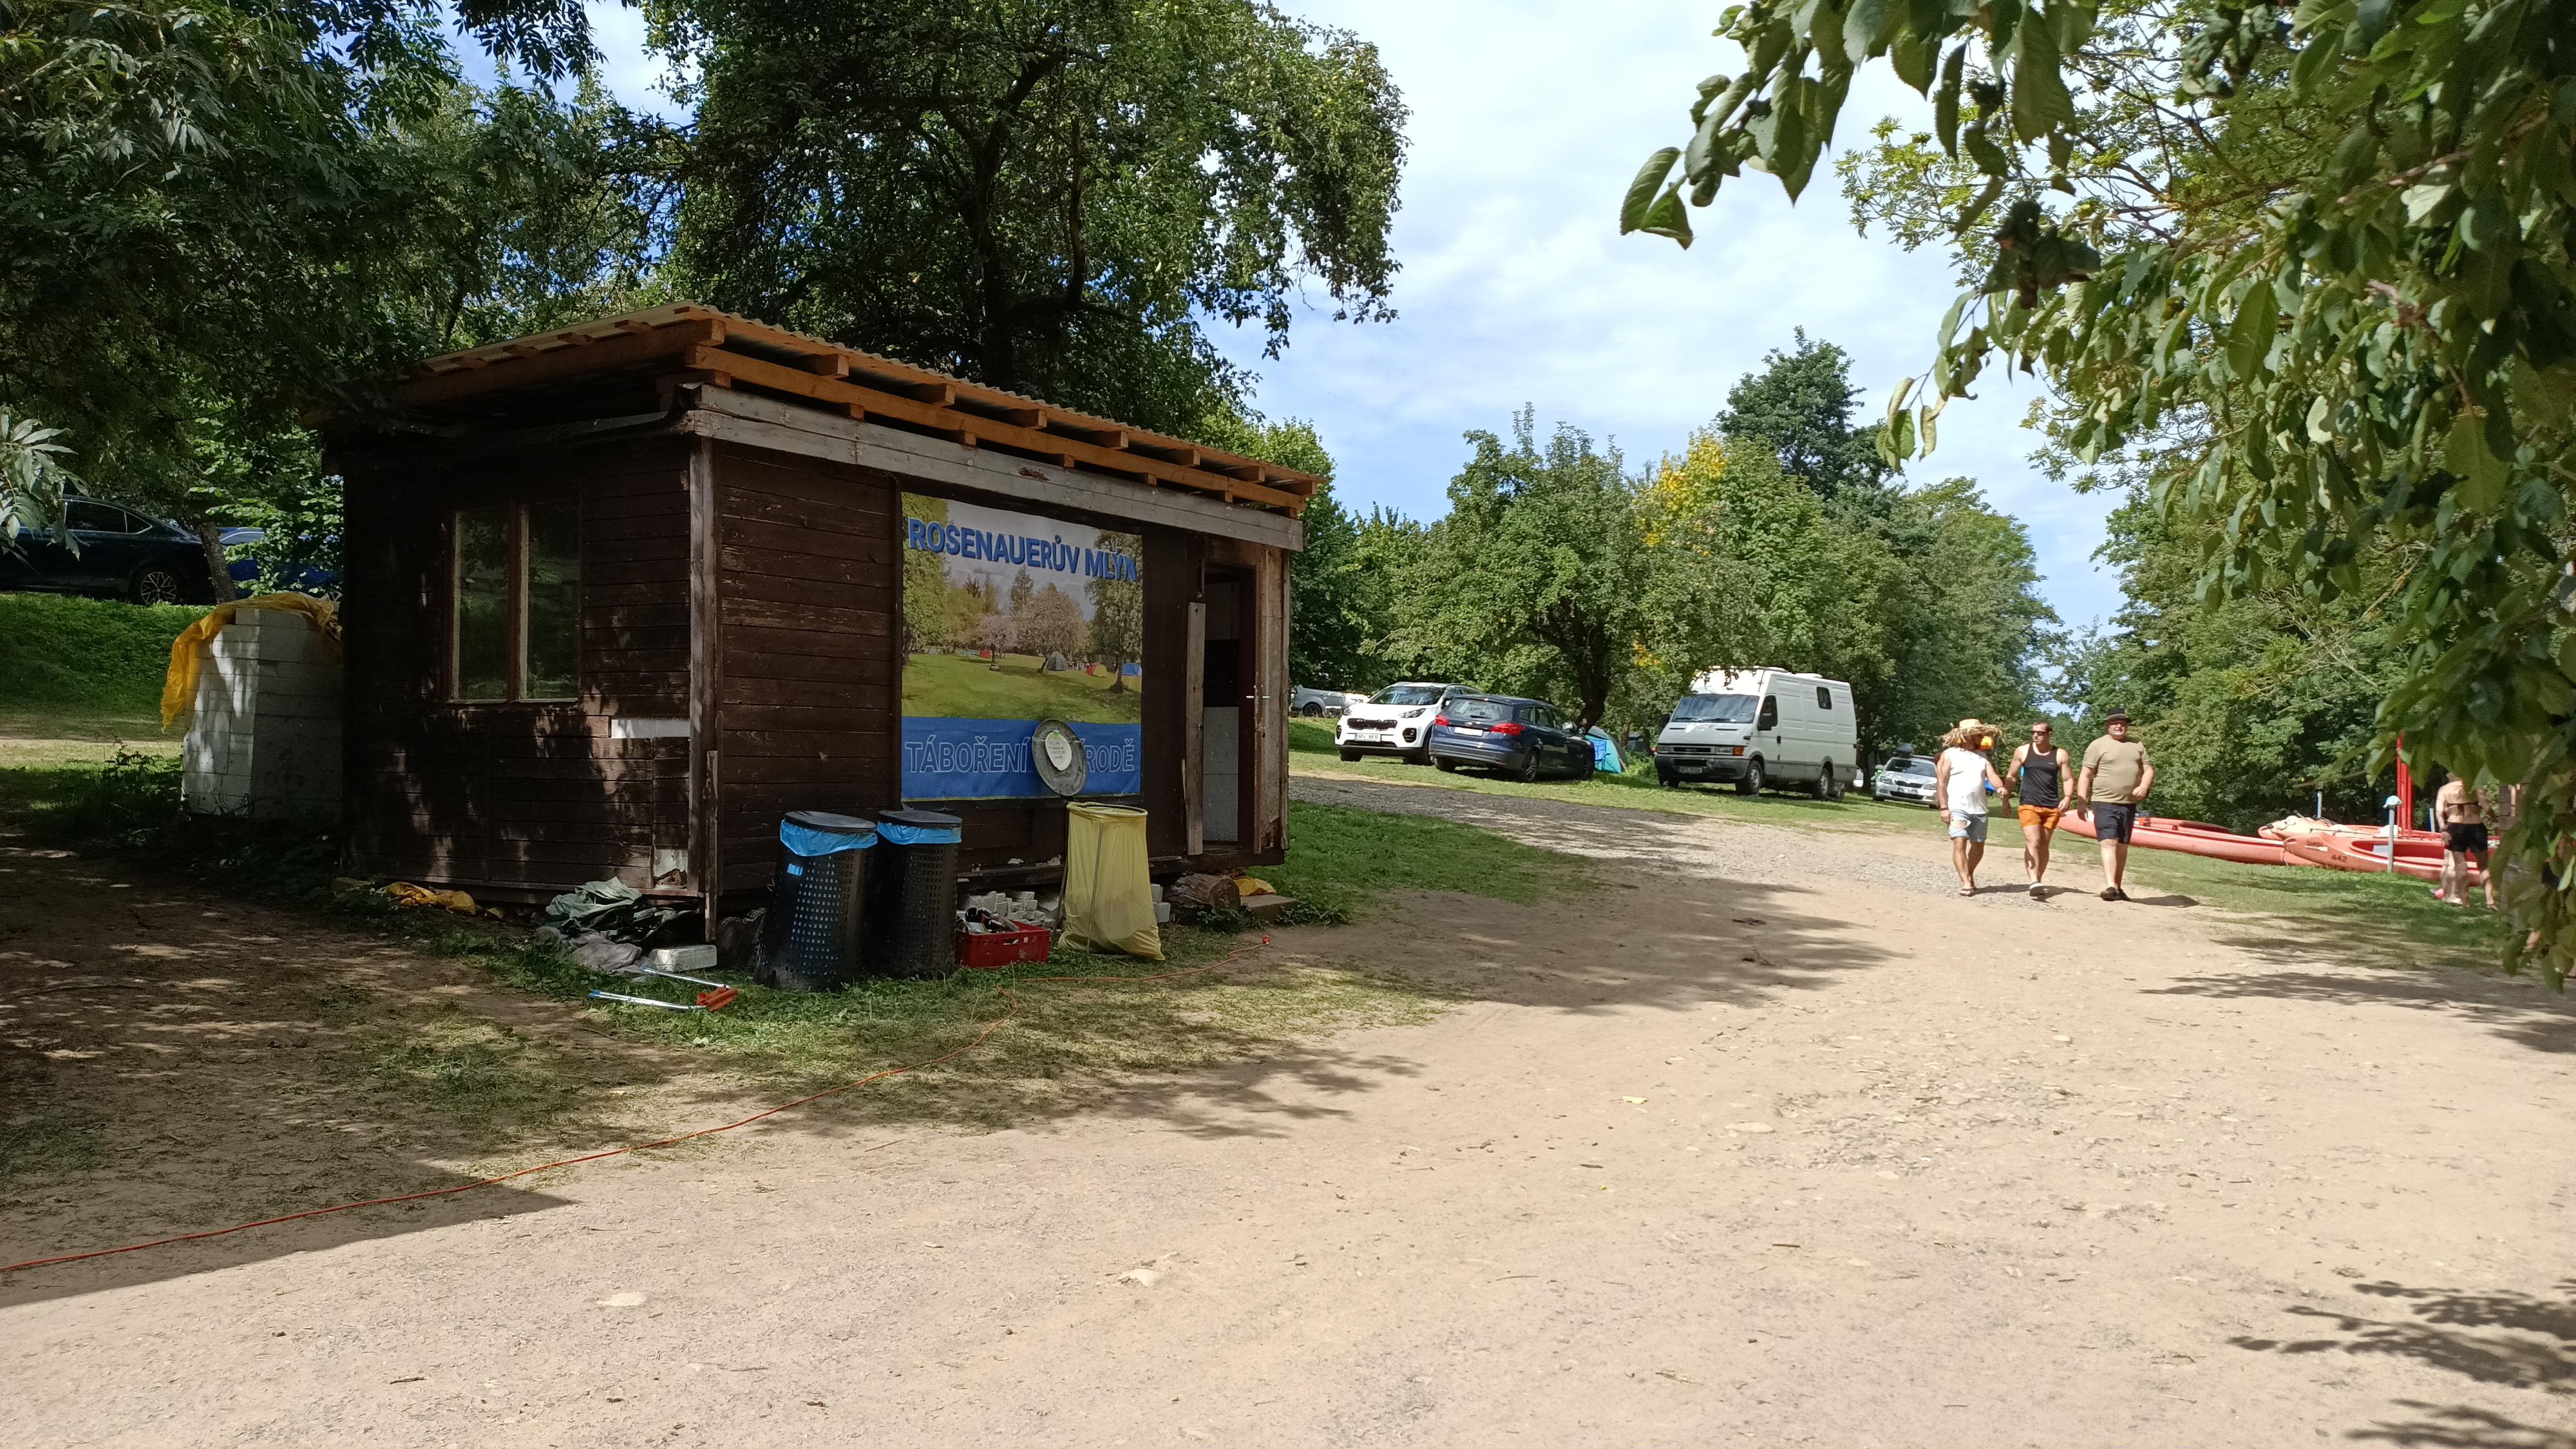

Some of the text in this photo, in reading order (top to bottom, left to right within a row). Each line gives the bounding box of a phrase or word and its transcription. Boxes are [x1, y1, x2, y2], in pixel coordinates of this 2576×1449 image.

[907, 517, 1137, 582] ROSENAUERŮV MLÝN
[905, 734, 1030, 773] TÁBOŘENÍ
[1080, 737, 1135, 773] RODĚ
[2331, 854, 2347, 862] 442
